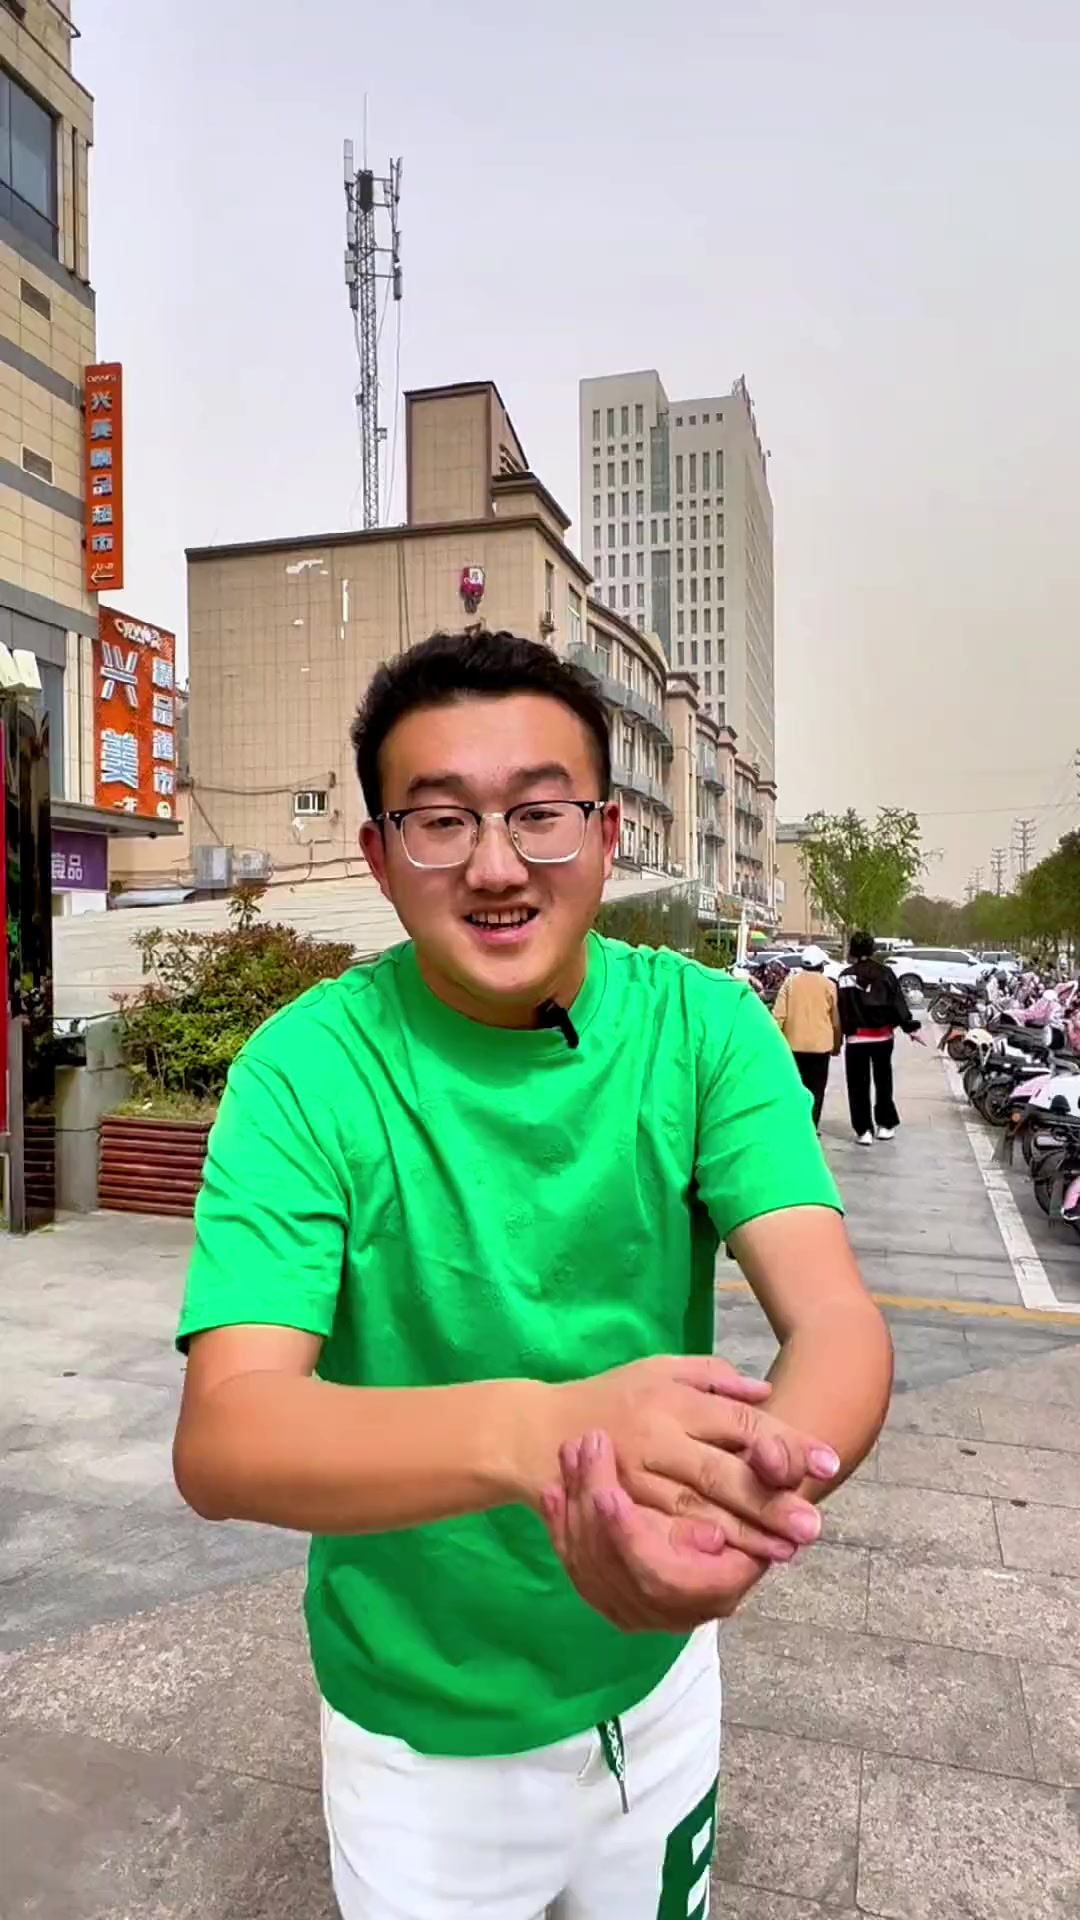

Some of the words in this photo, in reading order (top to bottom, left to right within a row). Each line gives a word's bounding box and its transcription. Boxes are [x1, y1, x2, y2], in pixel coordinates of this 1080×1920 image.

[99, 640, 139, 789] 兴美
[152, 656, 174, 796] 精品超市
